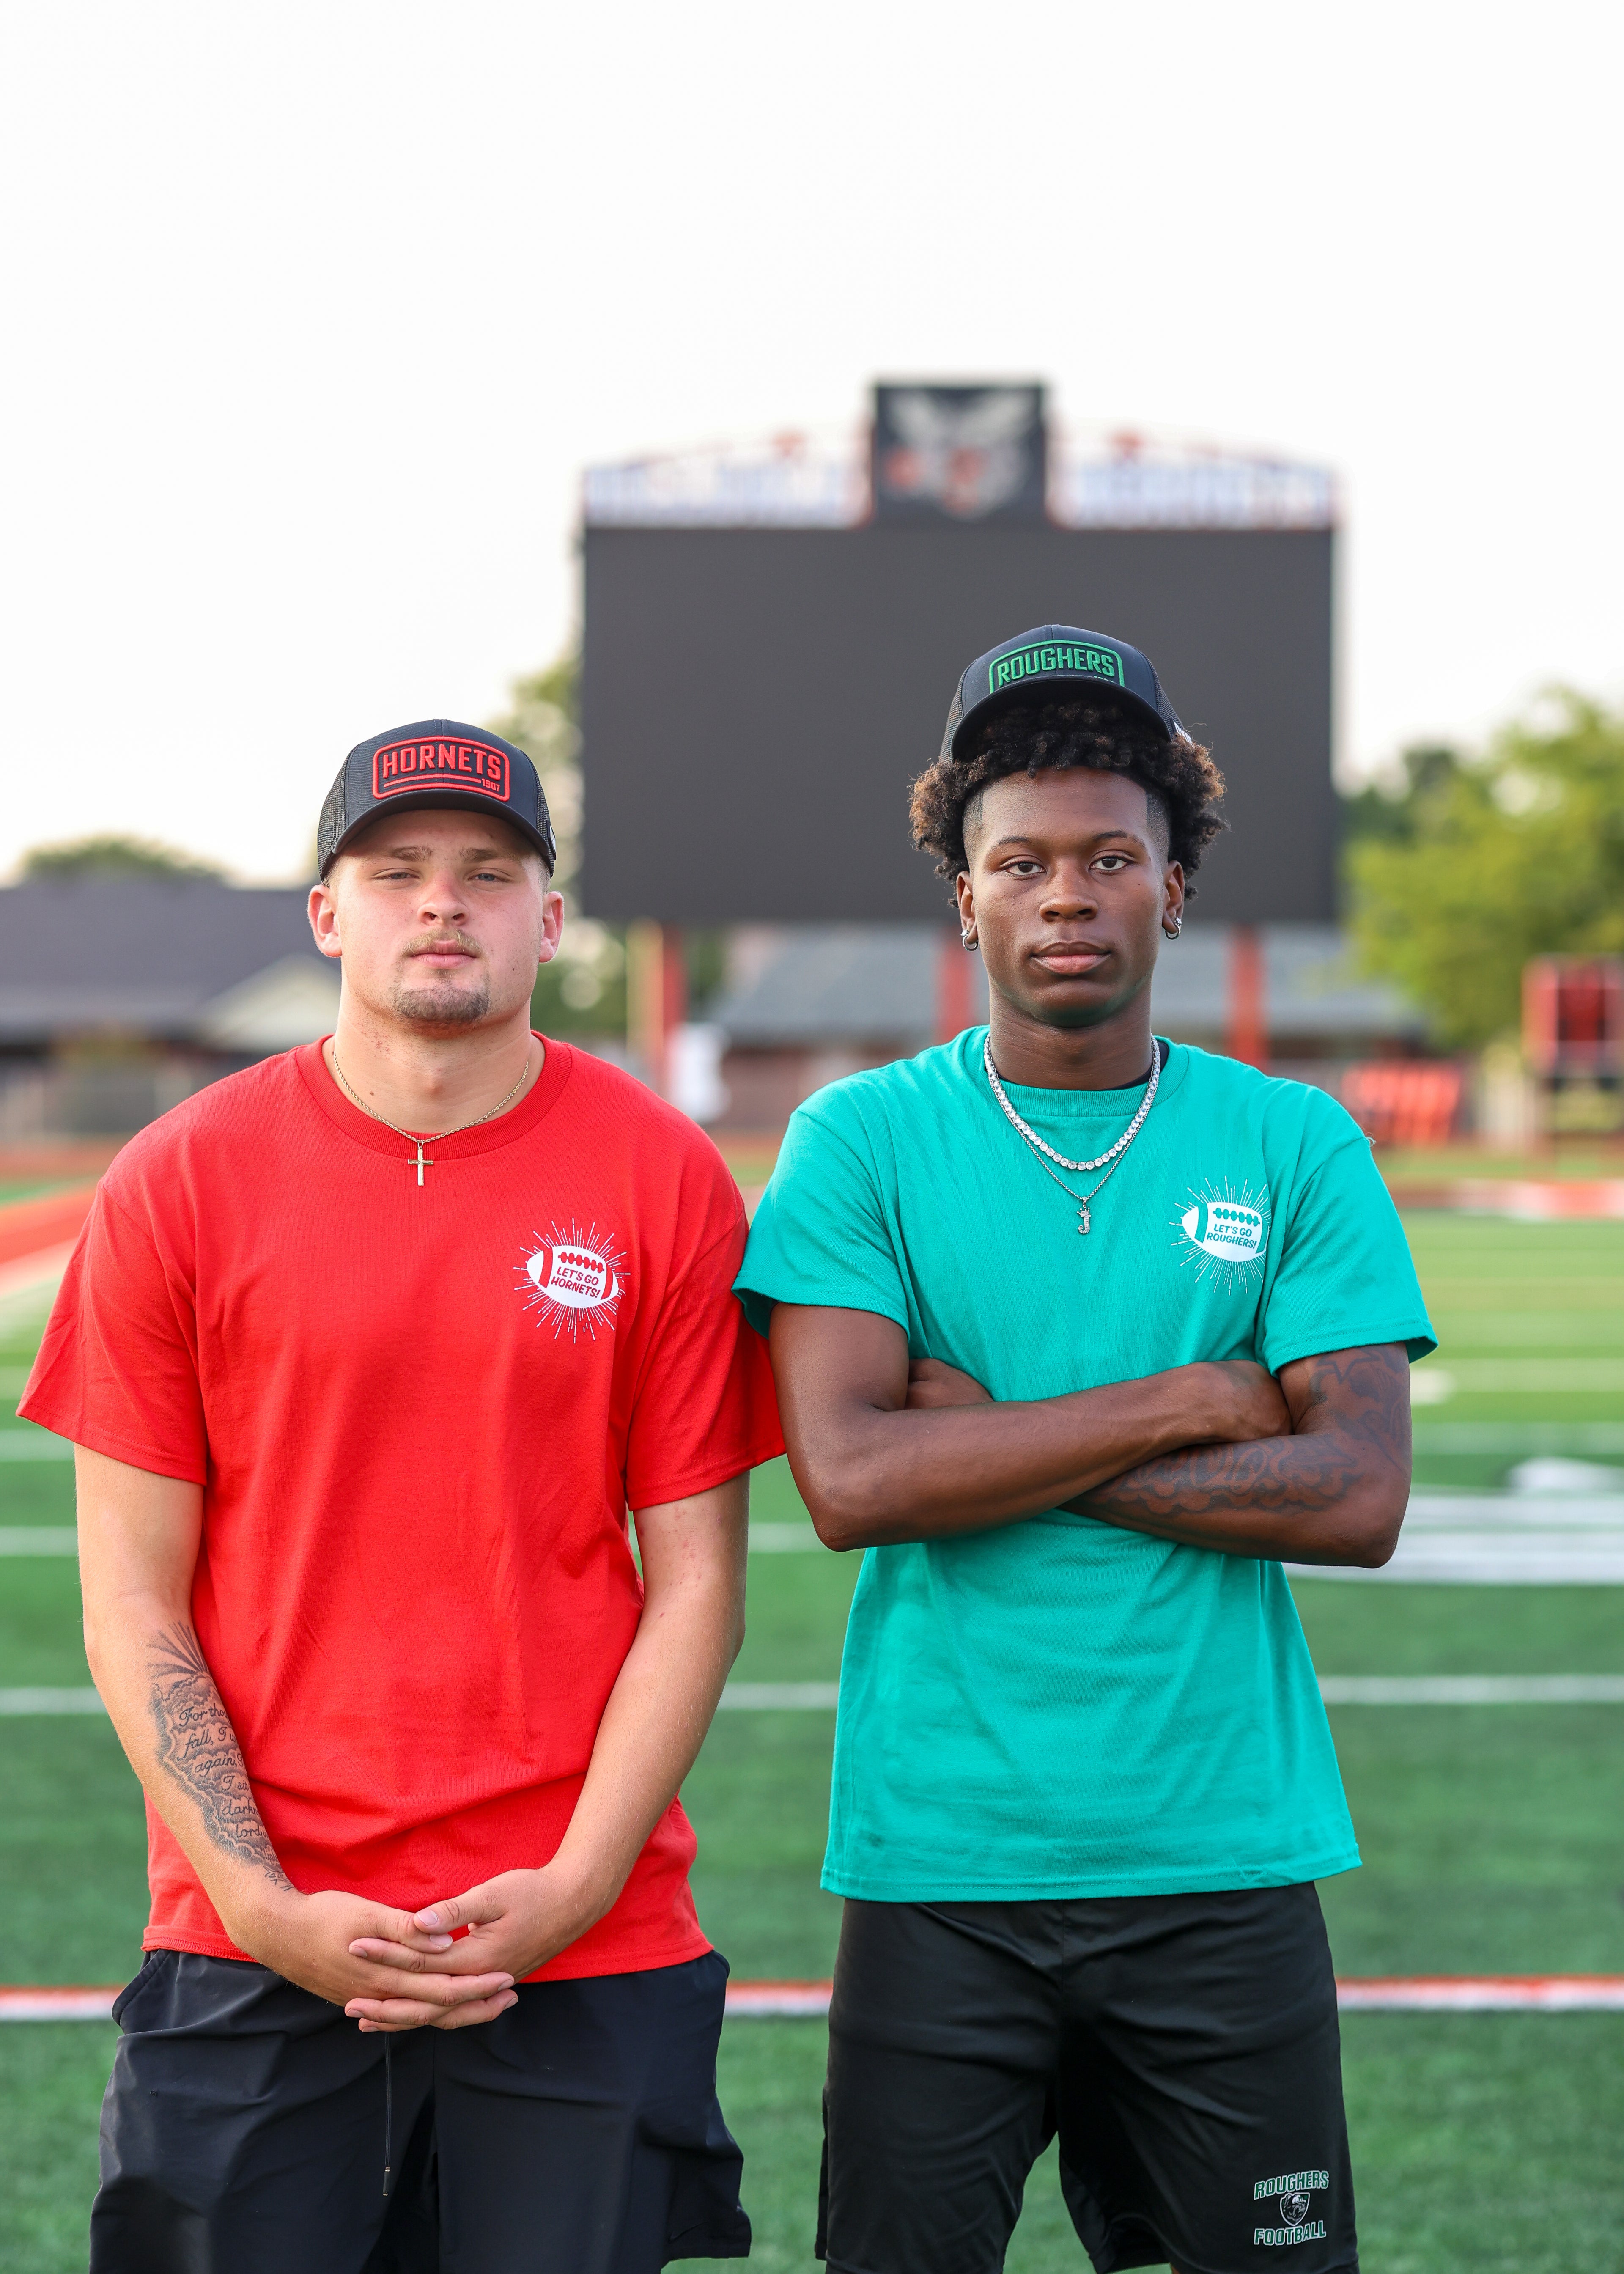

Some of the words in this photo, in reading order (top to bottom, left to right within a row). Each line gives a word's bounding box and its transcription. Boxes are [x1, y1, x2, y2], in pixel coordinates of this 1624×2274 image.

[997, 648, 1115, 687] ROUGHERS
[382, 744, 502, 781] HORNETS
[481, 778, 500, 792] 1907
[1206, 1232, 1257, 1249] ROUGHERS!
[1213, 1224, 1238, 1235] LET'S
[1239, 1228, 1252, 1237] GO
[557, 1266, 584, 1281] LET'S
[584, 1275, 599, 1286] GO
[551, 1276, 601, 1298] HORNETS!
[179, 1706, 208, 1727] For
[1254, 2170, 1330, 2200] ROUGHERS
[1254, 2220, 1327, 2246] FOOTBALL
